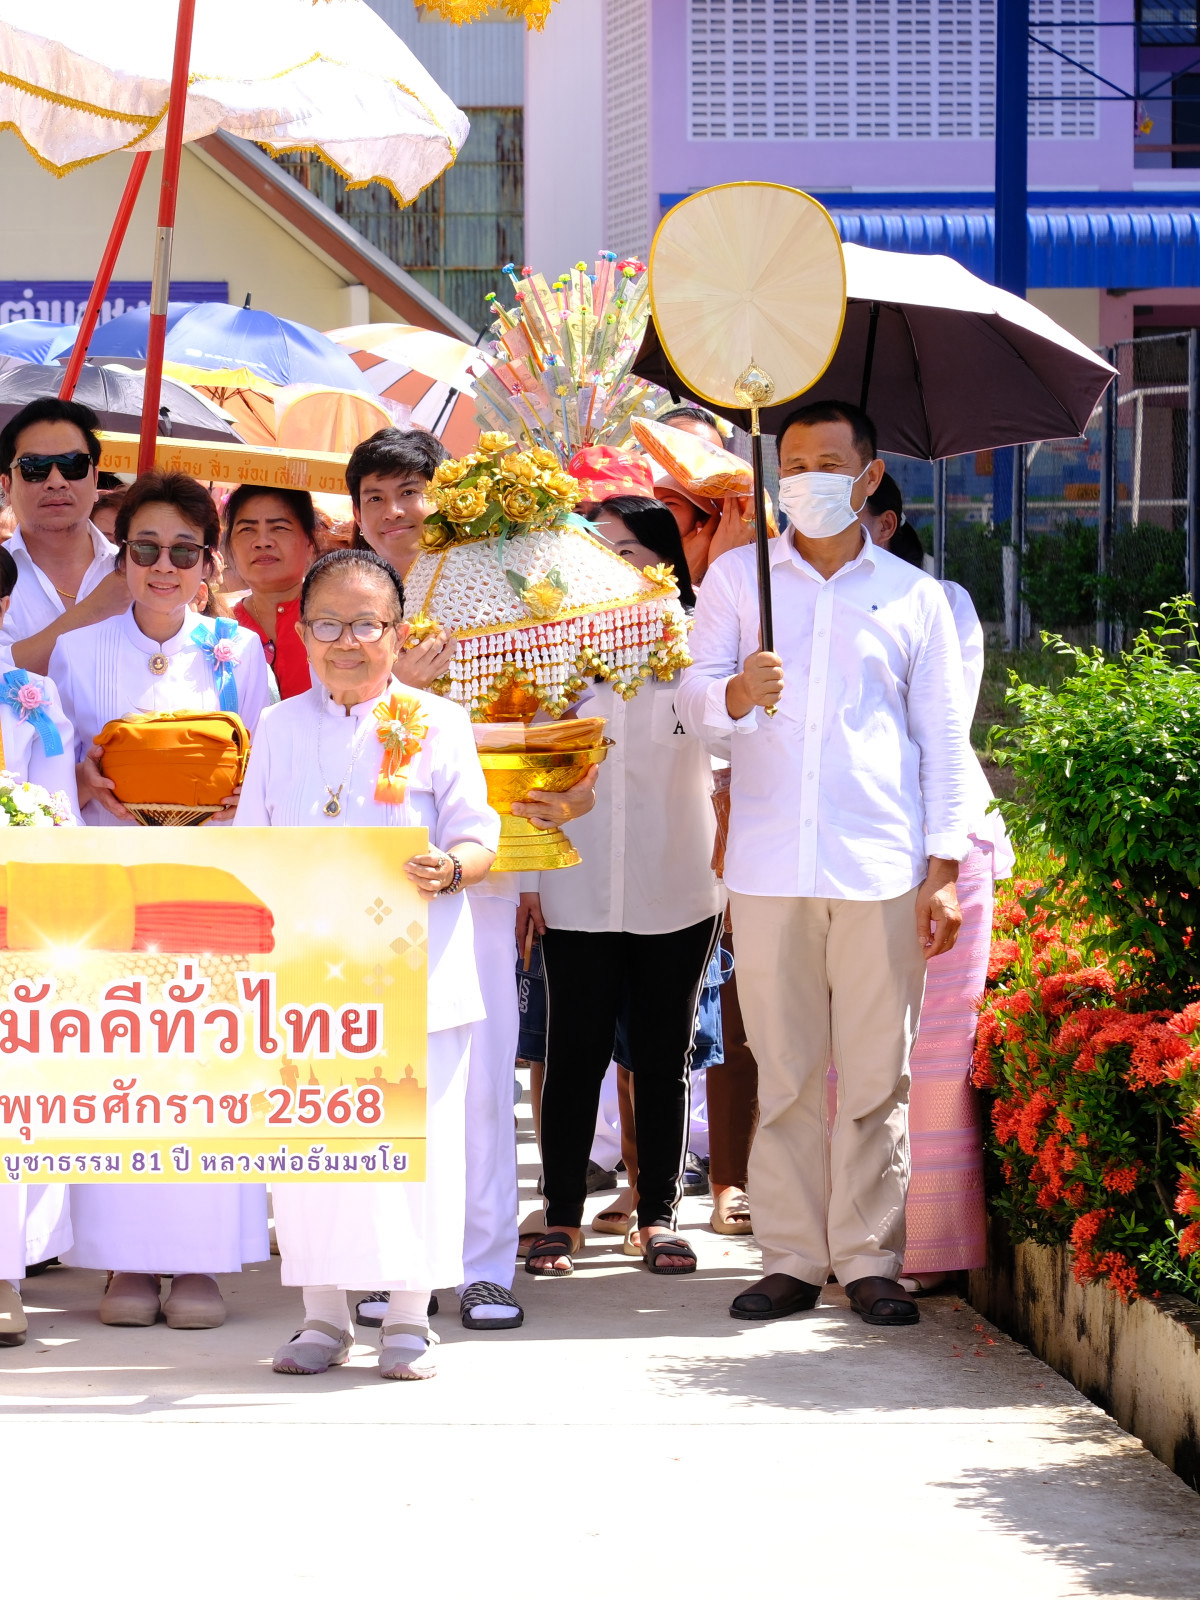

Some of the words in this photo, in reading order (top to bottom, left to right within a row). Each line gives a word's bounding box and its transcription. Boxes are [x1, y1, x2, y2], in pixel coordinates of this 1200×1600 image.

[208, 452, 231, 479] สิ่ว
[318, 475, 349, 491] ขวา
[266, 1087, 383, 1125] 2568
[4, 1151, 121, 1181] บูชาธรรม
[131, 1152, 162, 1172] 81
[172, 1145, 190, 1172] ปี
[200, 1144, 408, 1173] หลวงพ่อธัมมชโย
